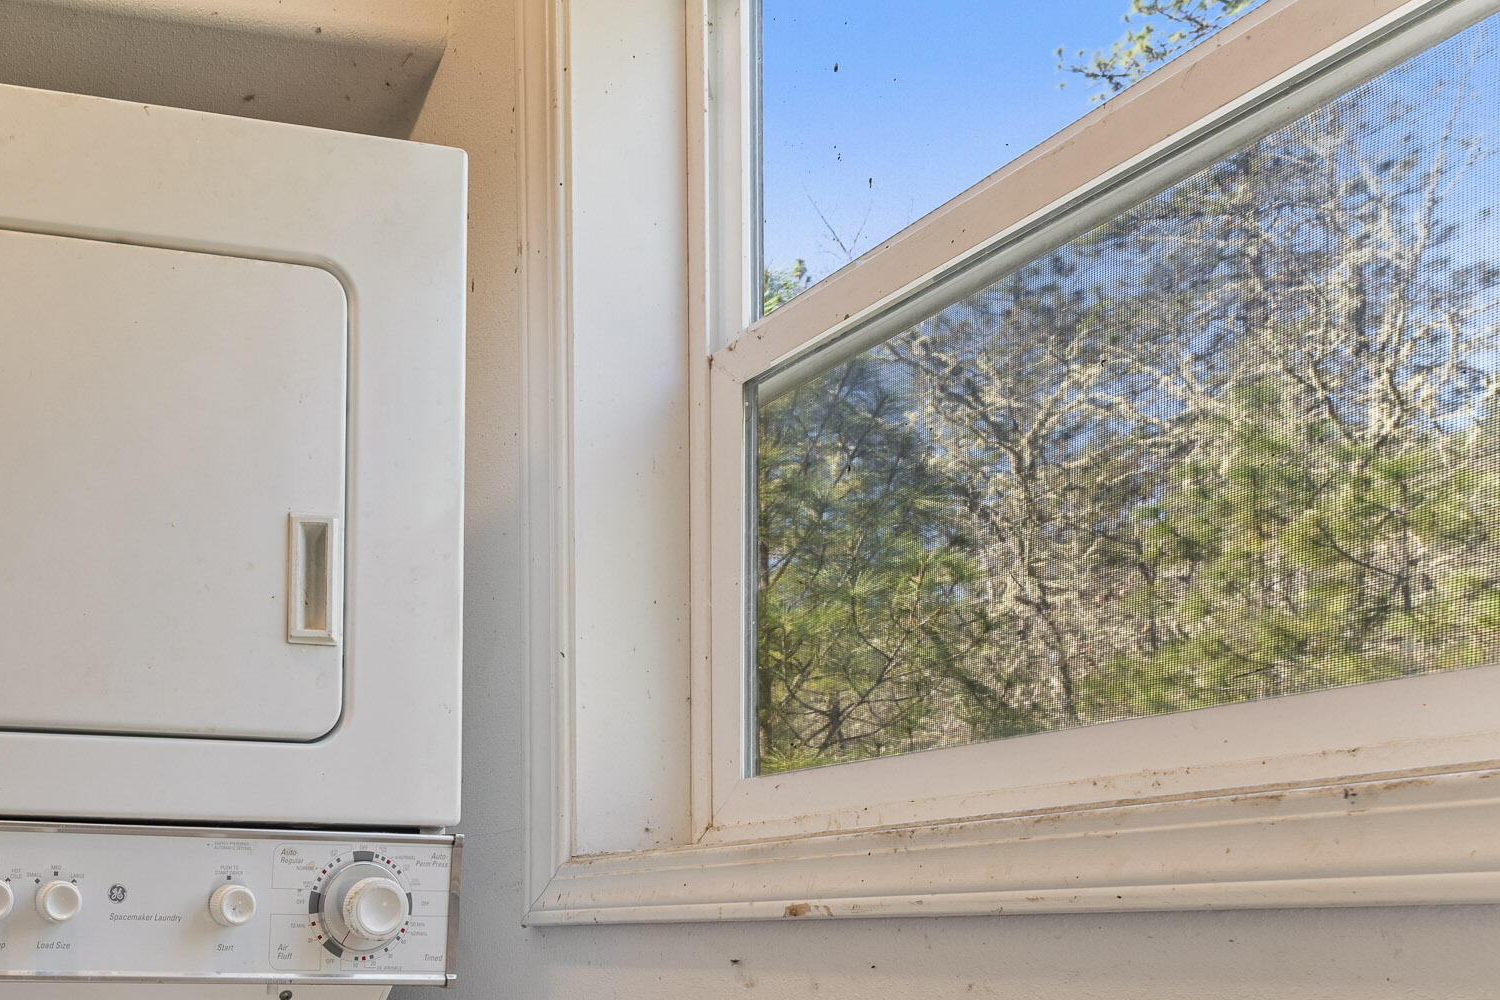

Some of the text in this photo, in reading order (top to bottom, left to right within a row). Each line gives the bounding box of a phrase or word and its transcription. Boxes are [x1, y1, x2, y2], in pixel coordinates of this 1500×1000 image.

[109, 913, 183, 922] Spacemaker Laundry
[36, 941, 71, 949] Load Size
